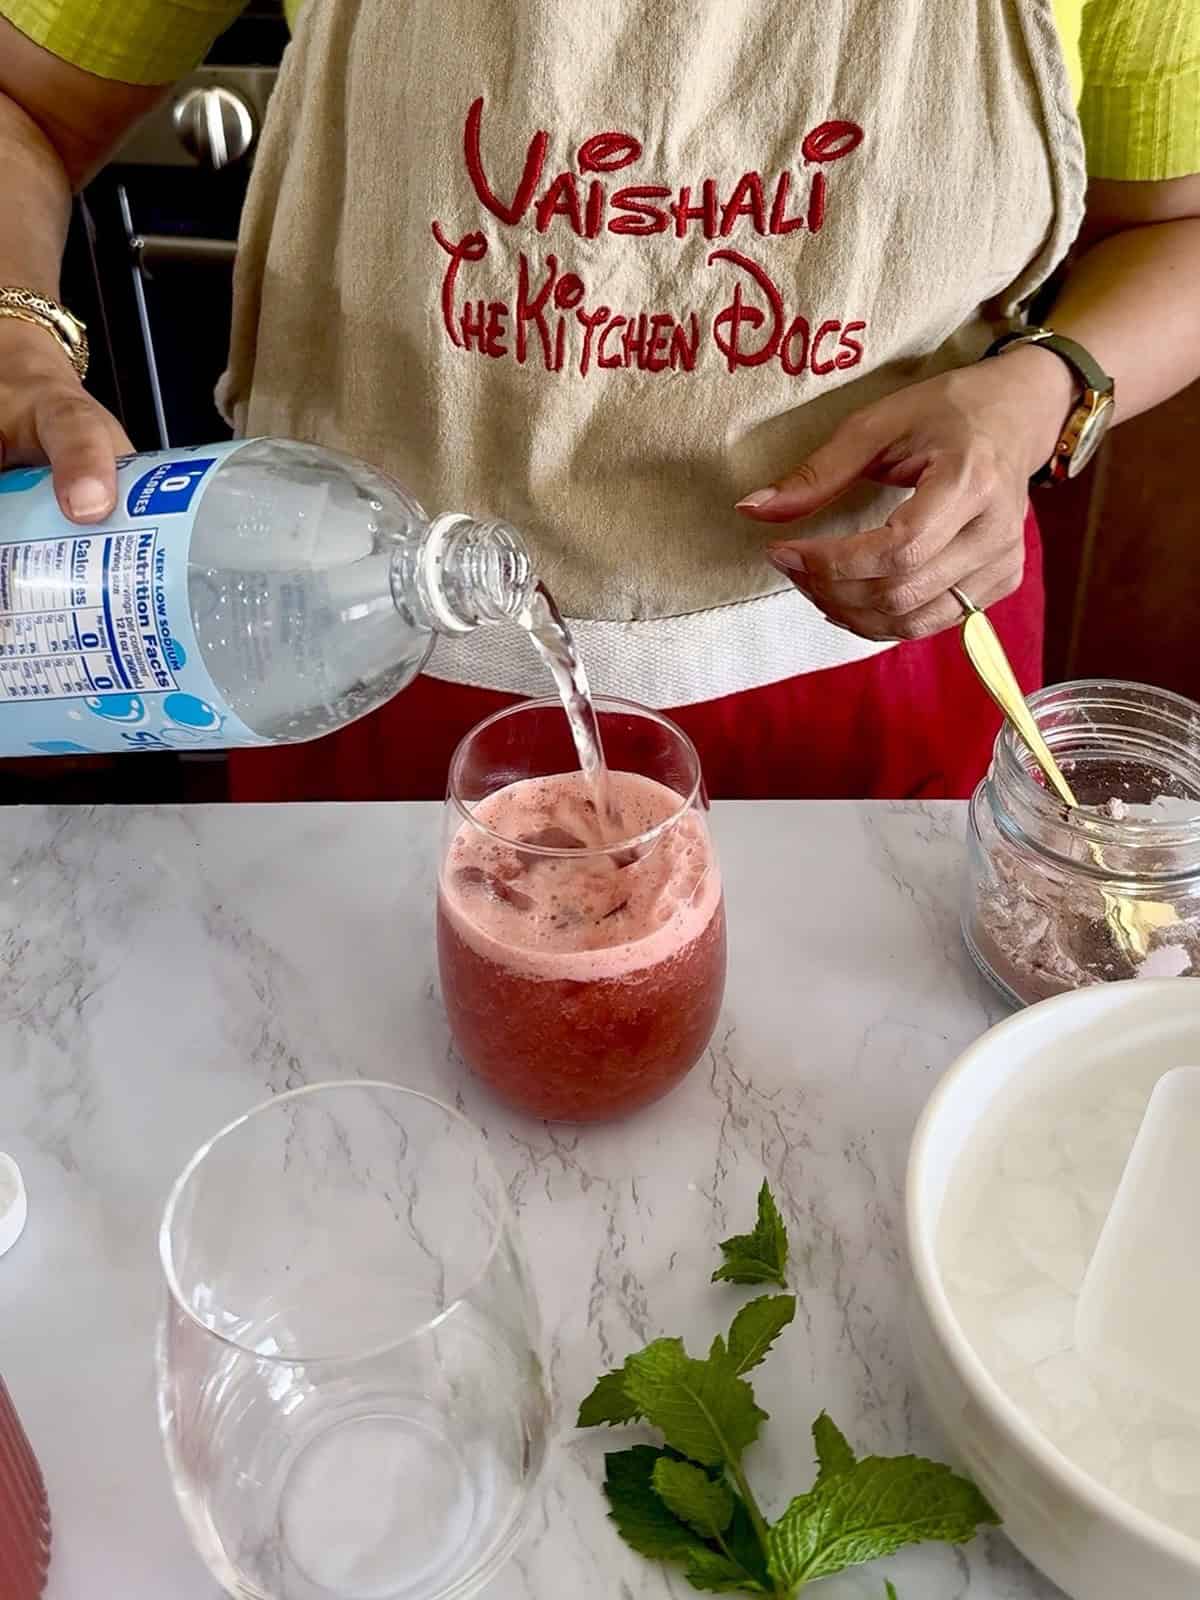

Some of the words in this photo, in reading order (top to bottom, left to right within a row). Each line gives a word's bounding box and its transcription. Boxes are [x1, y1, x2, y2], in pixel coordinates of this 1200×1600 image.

[707, 249, 866, 377] DOCS
[133, 464, 172, 515] CALORIES
[75, 539, 92, 605] Calores
[135, 533, 153, 627] Nutrition
[155, 547, 166, 582] VERY
[155, 586, 167, 617] LOW
[81, 633, 100, 648] 0
[142, 634, 170, 688] Facts
[159, 619, 182, 671] SODIUM
[94, 676, 114, 689] 0
